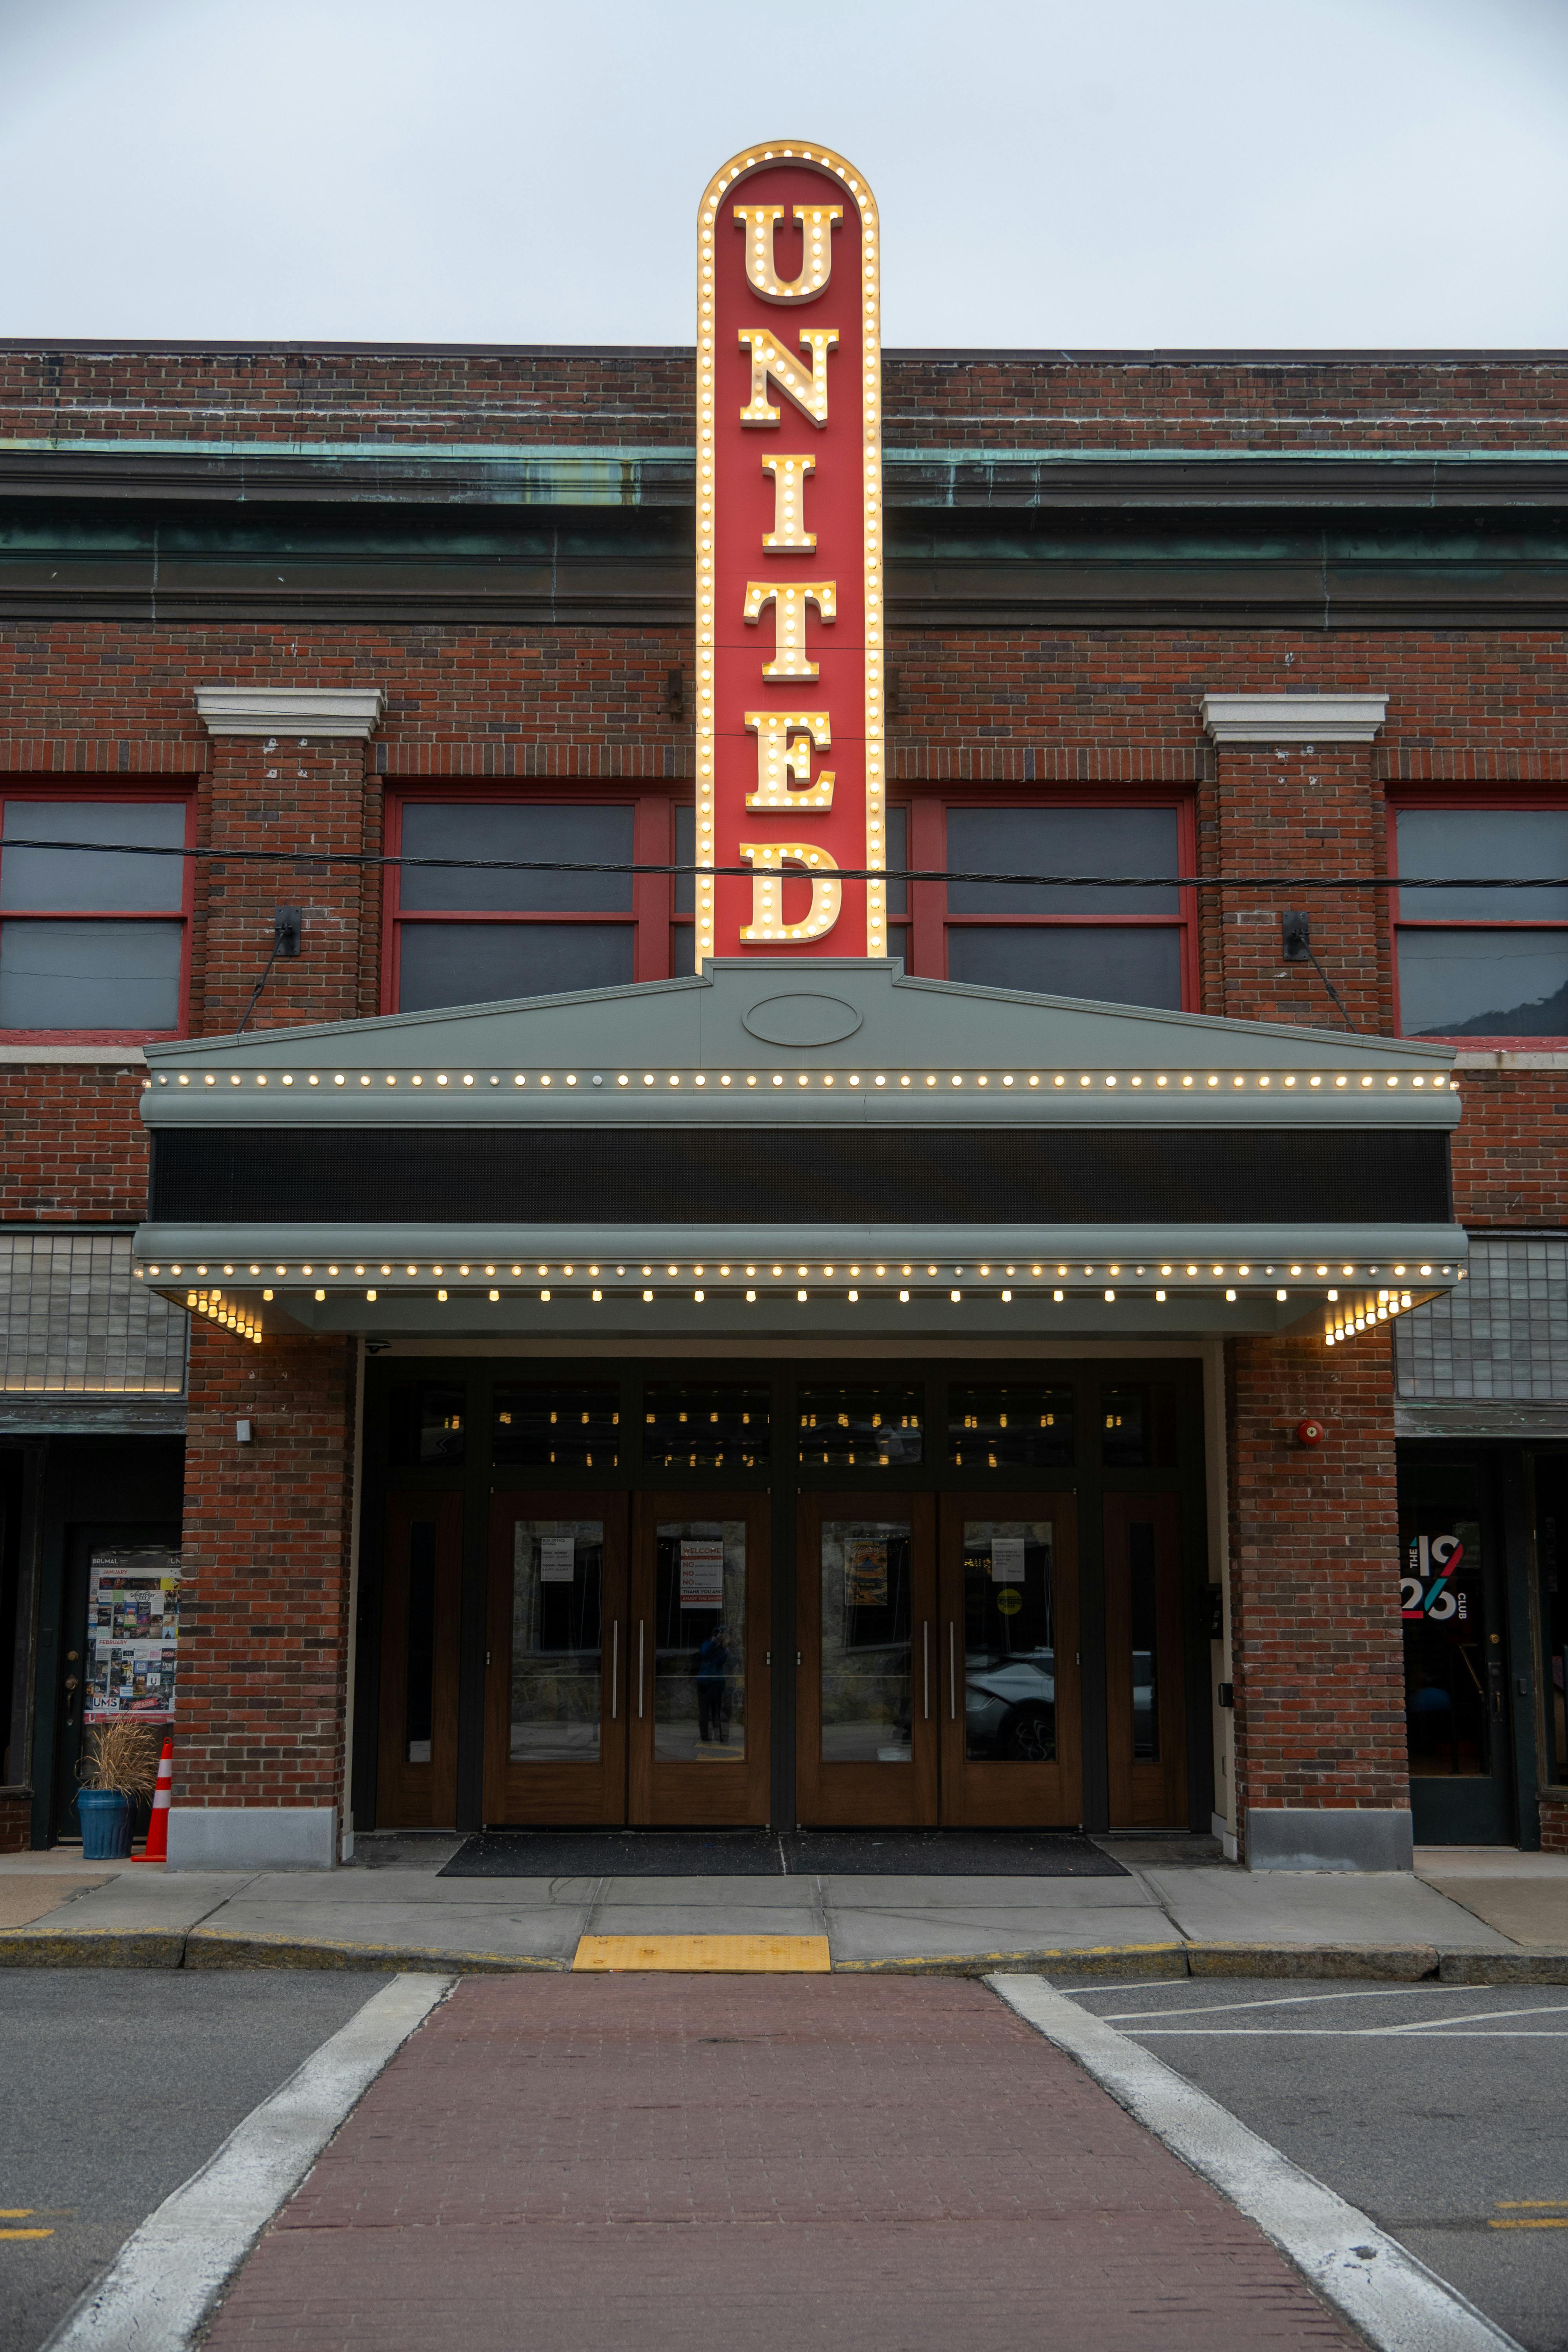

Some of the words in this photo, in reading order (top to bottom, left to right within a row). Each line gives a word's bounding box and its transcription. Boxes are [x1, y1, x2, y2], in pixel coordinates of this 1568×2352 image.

[733, 204, 844, 944] UNITED
[851, 1546, 882, 1557] January
[1409, 1535, 1463, 1576] 19
[1409, 1549, 1418, 1568] THE
[1400, 1577, 1456, 1619] 26
[1458, 1593, 1467, 1619] CLUB
[94, 1698, 117, 1707] UMS
[89, 1714, 96, 1722] U
